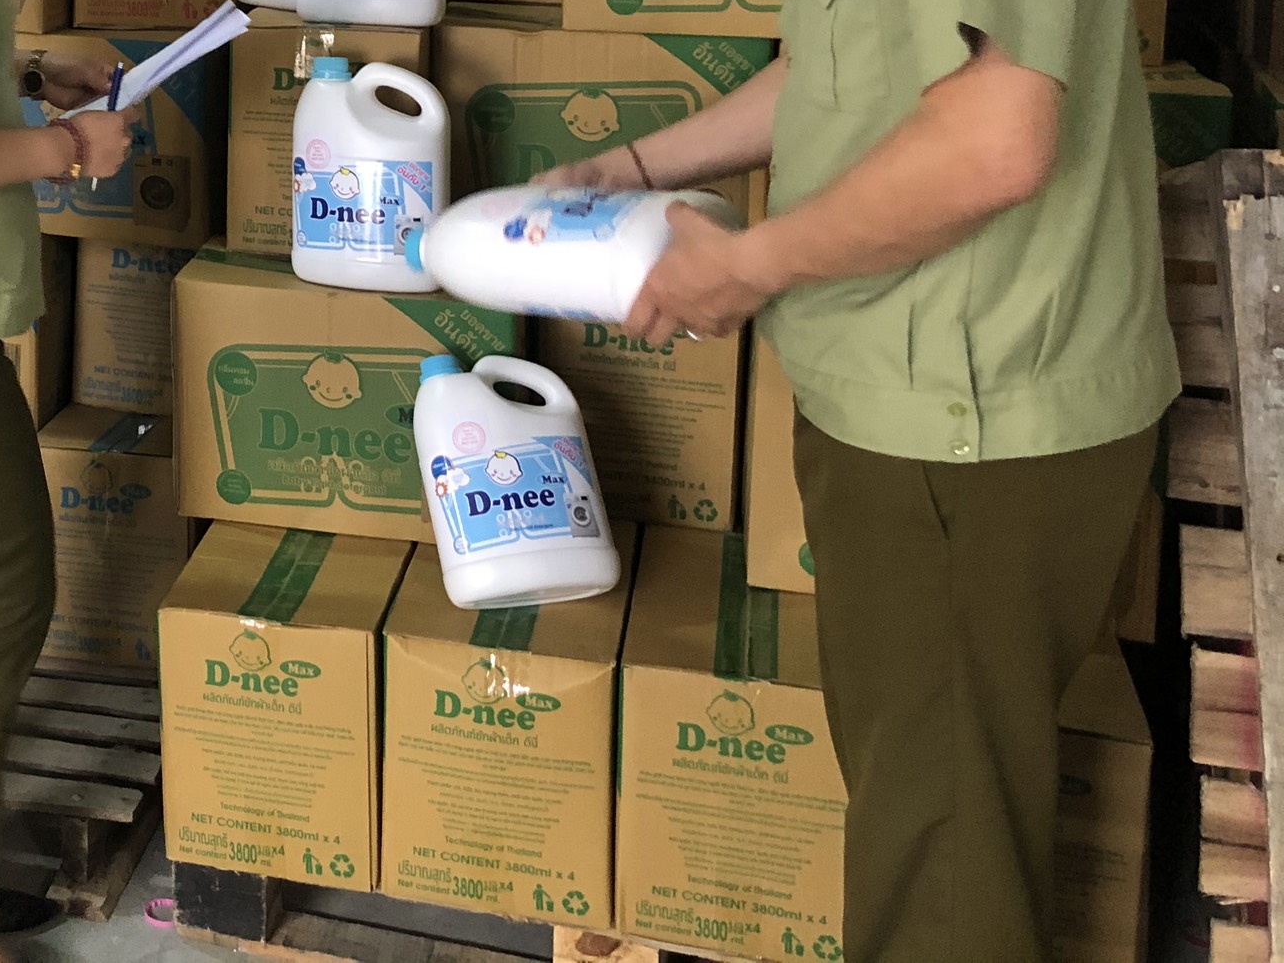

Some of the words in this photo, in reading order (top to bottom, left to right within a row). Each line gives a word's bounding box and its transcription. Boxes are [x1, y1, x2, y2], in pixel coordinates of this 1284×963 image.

[255, 205, 275, 215] NET
[310, 197, 386, 225] D-nee
[434, 308, 484, 361] อันดับ
[460, 309, 506, 352] ยอดขาย
[258, 407, 412, 464] D-nee
[541, 475, 565, 485] Max
[699, 481, 706, 491] 4
[60, 485, 134, 515] D-nee
[465, 489, 555, 517] D-nee
[205, 659, 298, 697] D-nee
[287, 663, 314, 677] Max
[434, 689, 535, 730] D-nee
[524, 694, 554, 710] Max
[676, 721, 787, 765] D-nee
[775, 727, 807, 743] Max
[220, 801, 265, 817] Technology
[191, 812, 213, 824] NET
[217, 816, 272, 834] CONTENT
[276, 825, 319, 841] 3800ml
[333, 835, 341, 844] 4
[179, 844, 193, 853] Net
[195, 849, 227, 859] content
[229, 841, 257, 864] 3800
[445, 835, 494, 852] Technology
[413, 846, 437, 858] NET
[440, 850, 500, 869] CONTENT
[505, 861, 552, 877] 3800ml
[567, 871, 575, 881] 4
[398, 878, 413, 888] Net
[416, 883, 450, 895] content
[453, 875, 483, 900] 3800
[652, 885, 677, 898] NET
[682, 890, 748, 910] CONTENT
[752, 902, 803, 921] 3800ml
[806, 915, 814, 923] x
[819, 915, 827, 925] 4
[635, 918, 652, 929] Net
[655, 923, 692, 936] content
[694, 916, 727, 942] 3800
